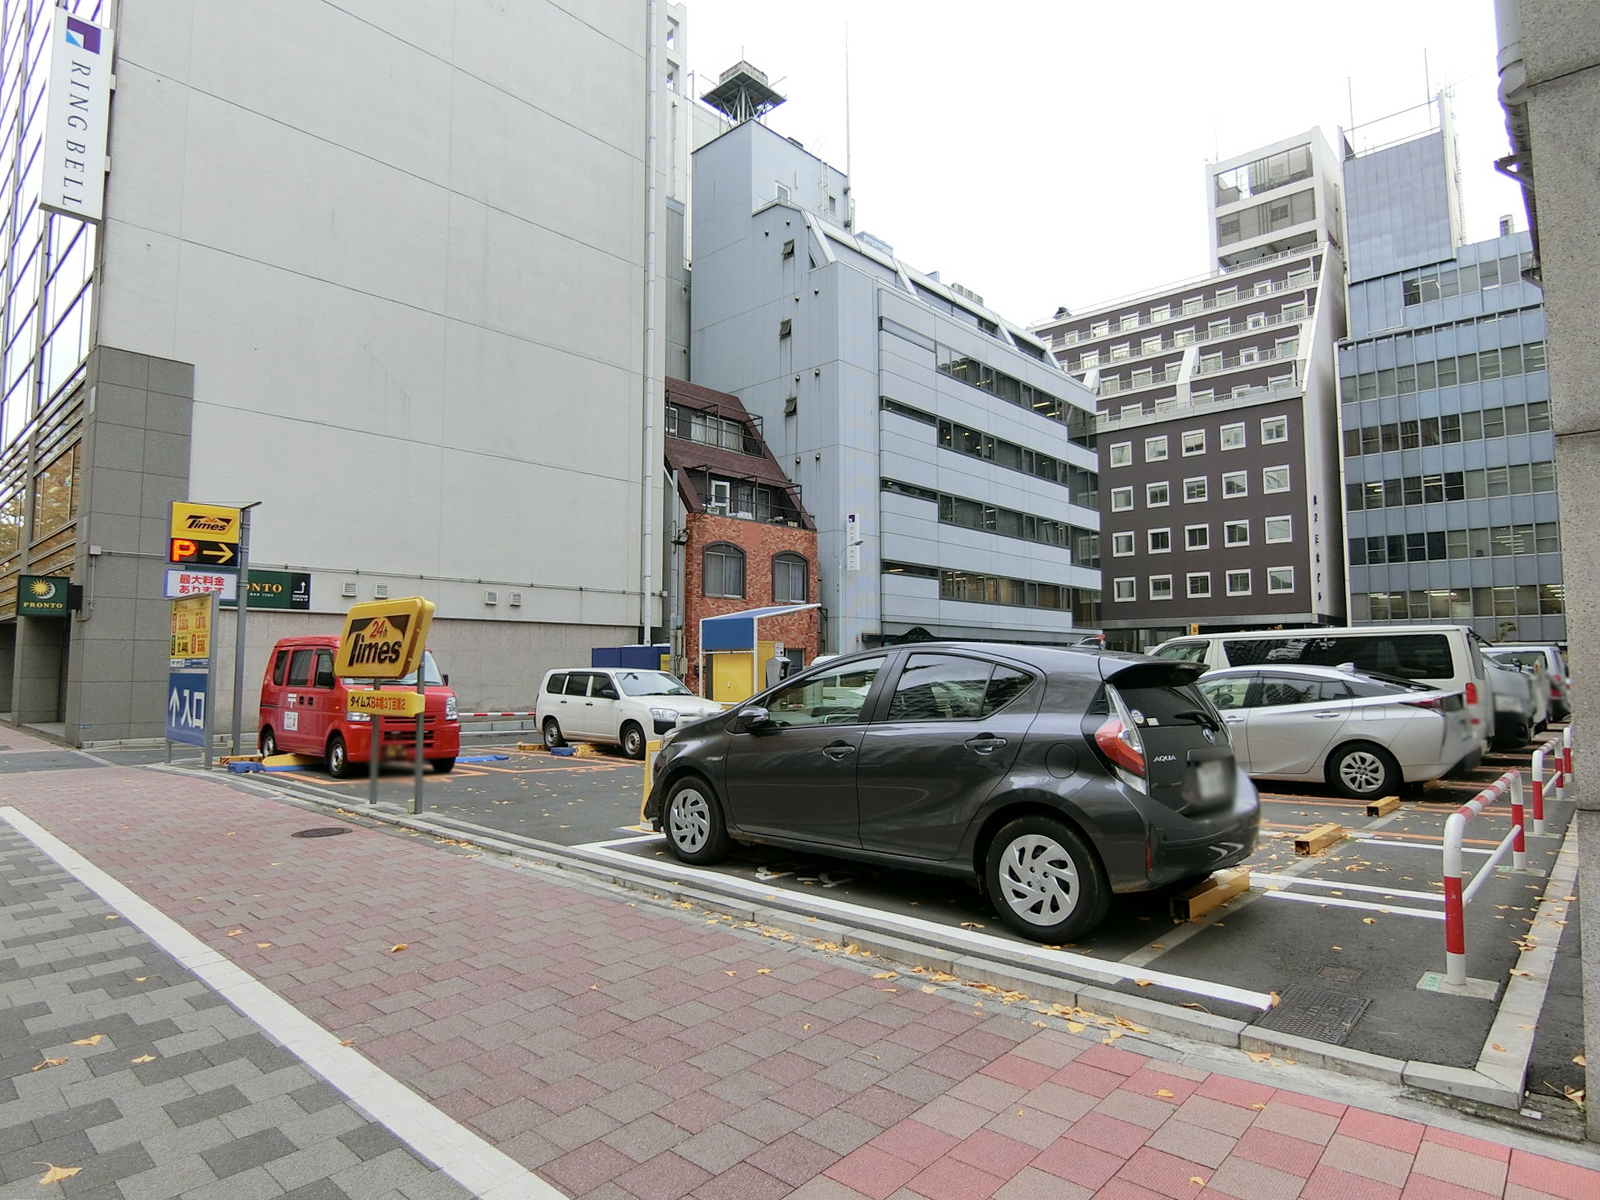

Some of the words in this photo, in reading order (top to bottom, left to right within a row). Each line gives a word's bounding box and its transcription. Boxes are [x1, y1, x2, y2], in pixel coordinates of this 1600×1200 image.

[186, 515, 228, 531] Times
[171, 539, 197, 561] P
[179, 574, 225, 586] 最大料金
[23, 601, 63, 609] PRONTO
[369, 620, 389, 638] 24h
[347, 632, 402, 667] Times
[180, 688, 205, 729] 入口
[1153, 755, 1177, 763] AQUA
